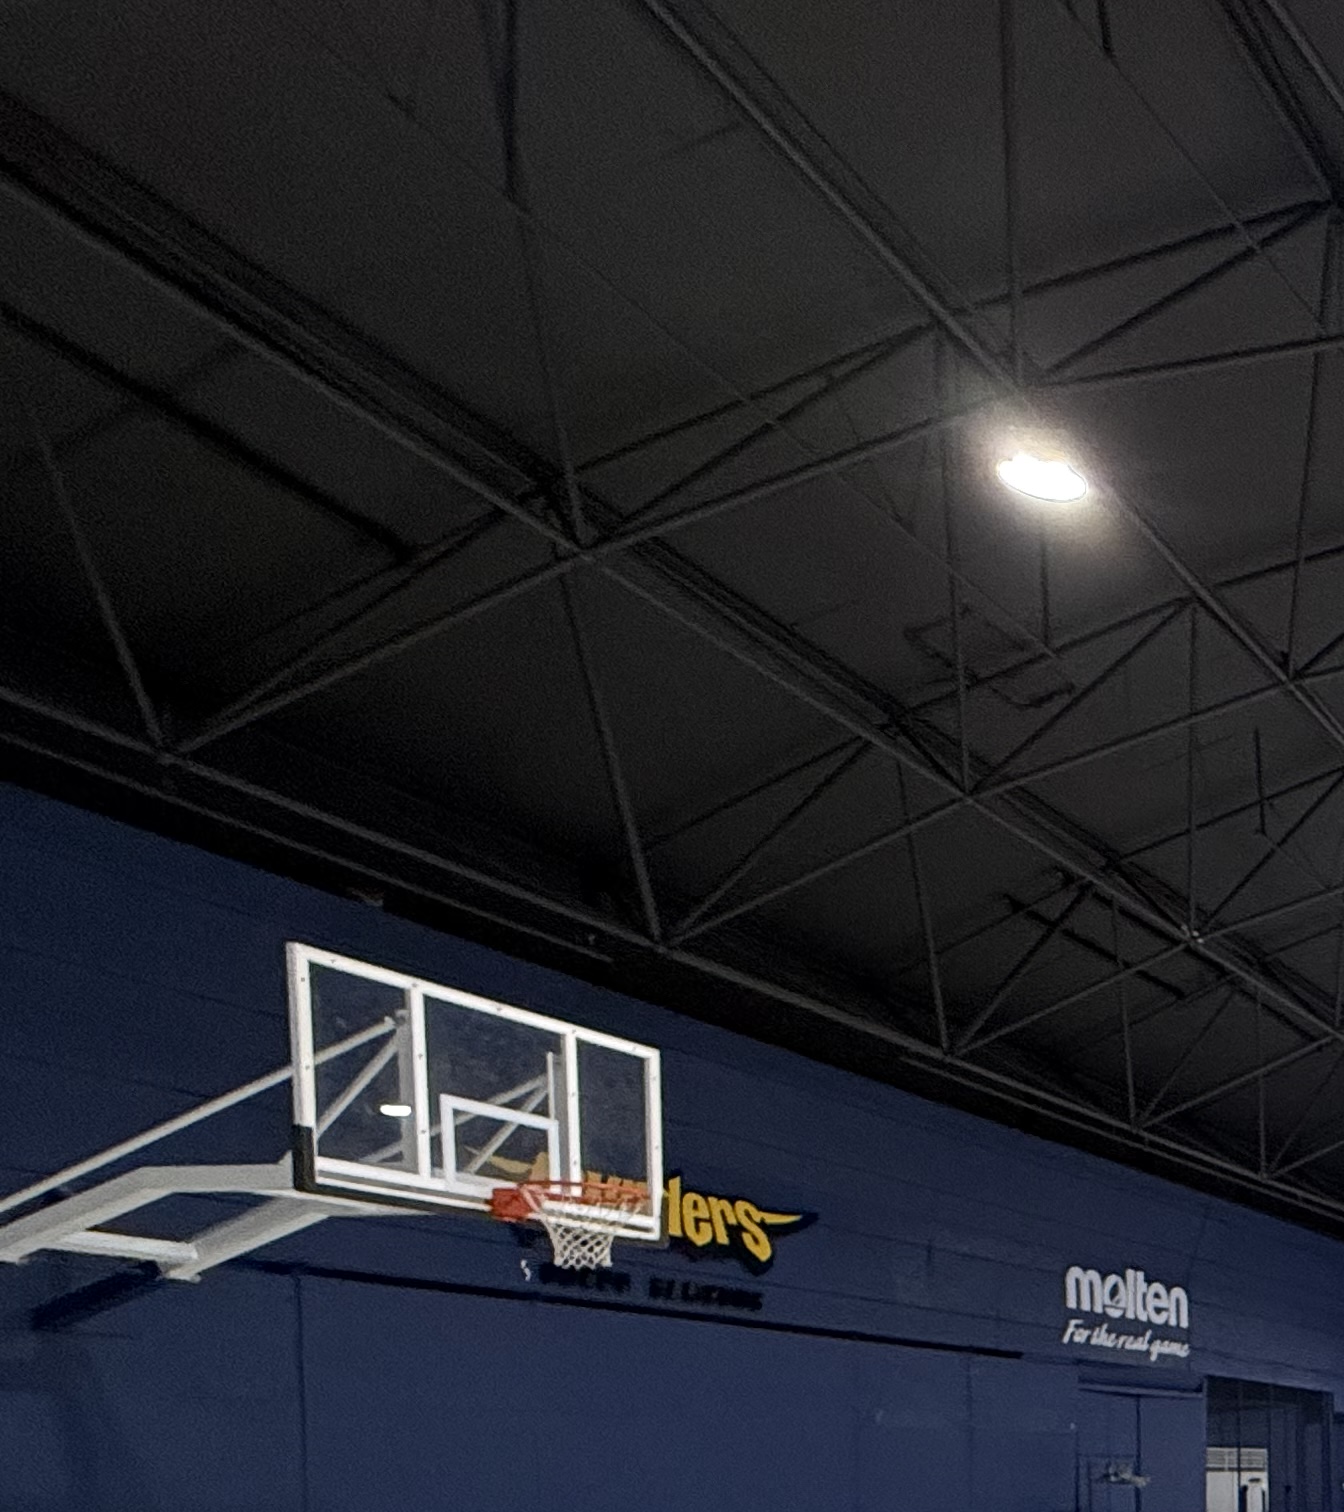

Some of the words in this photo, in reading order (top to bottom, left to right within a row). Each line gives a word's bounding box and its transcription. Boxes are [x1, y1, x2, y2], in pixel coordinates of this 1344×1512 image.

[1065, 1265, 1189, 1328] molten
[1062, 1318, 1091, 1344] For
[1090, 1323, 1117, 1347] the
[1116, 1328, 1152, 1352] real
[1149, 1338, 1190, 1362] game
